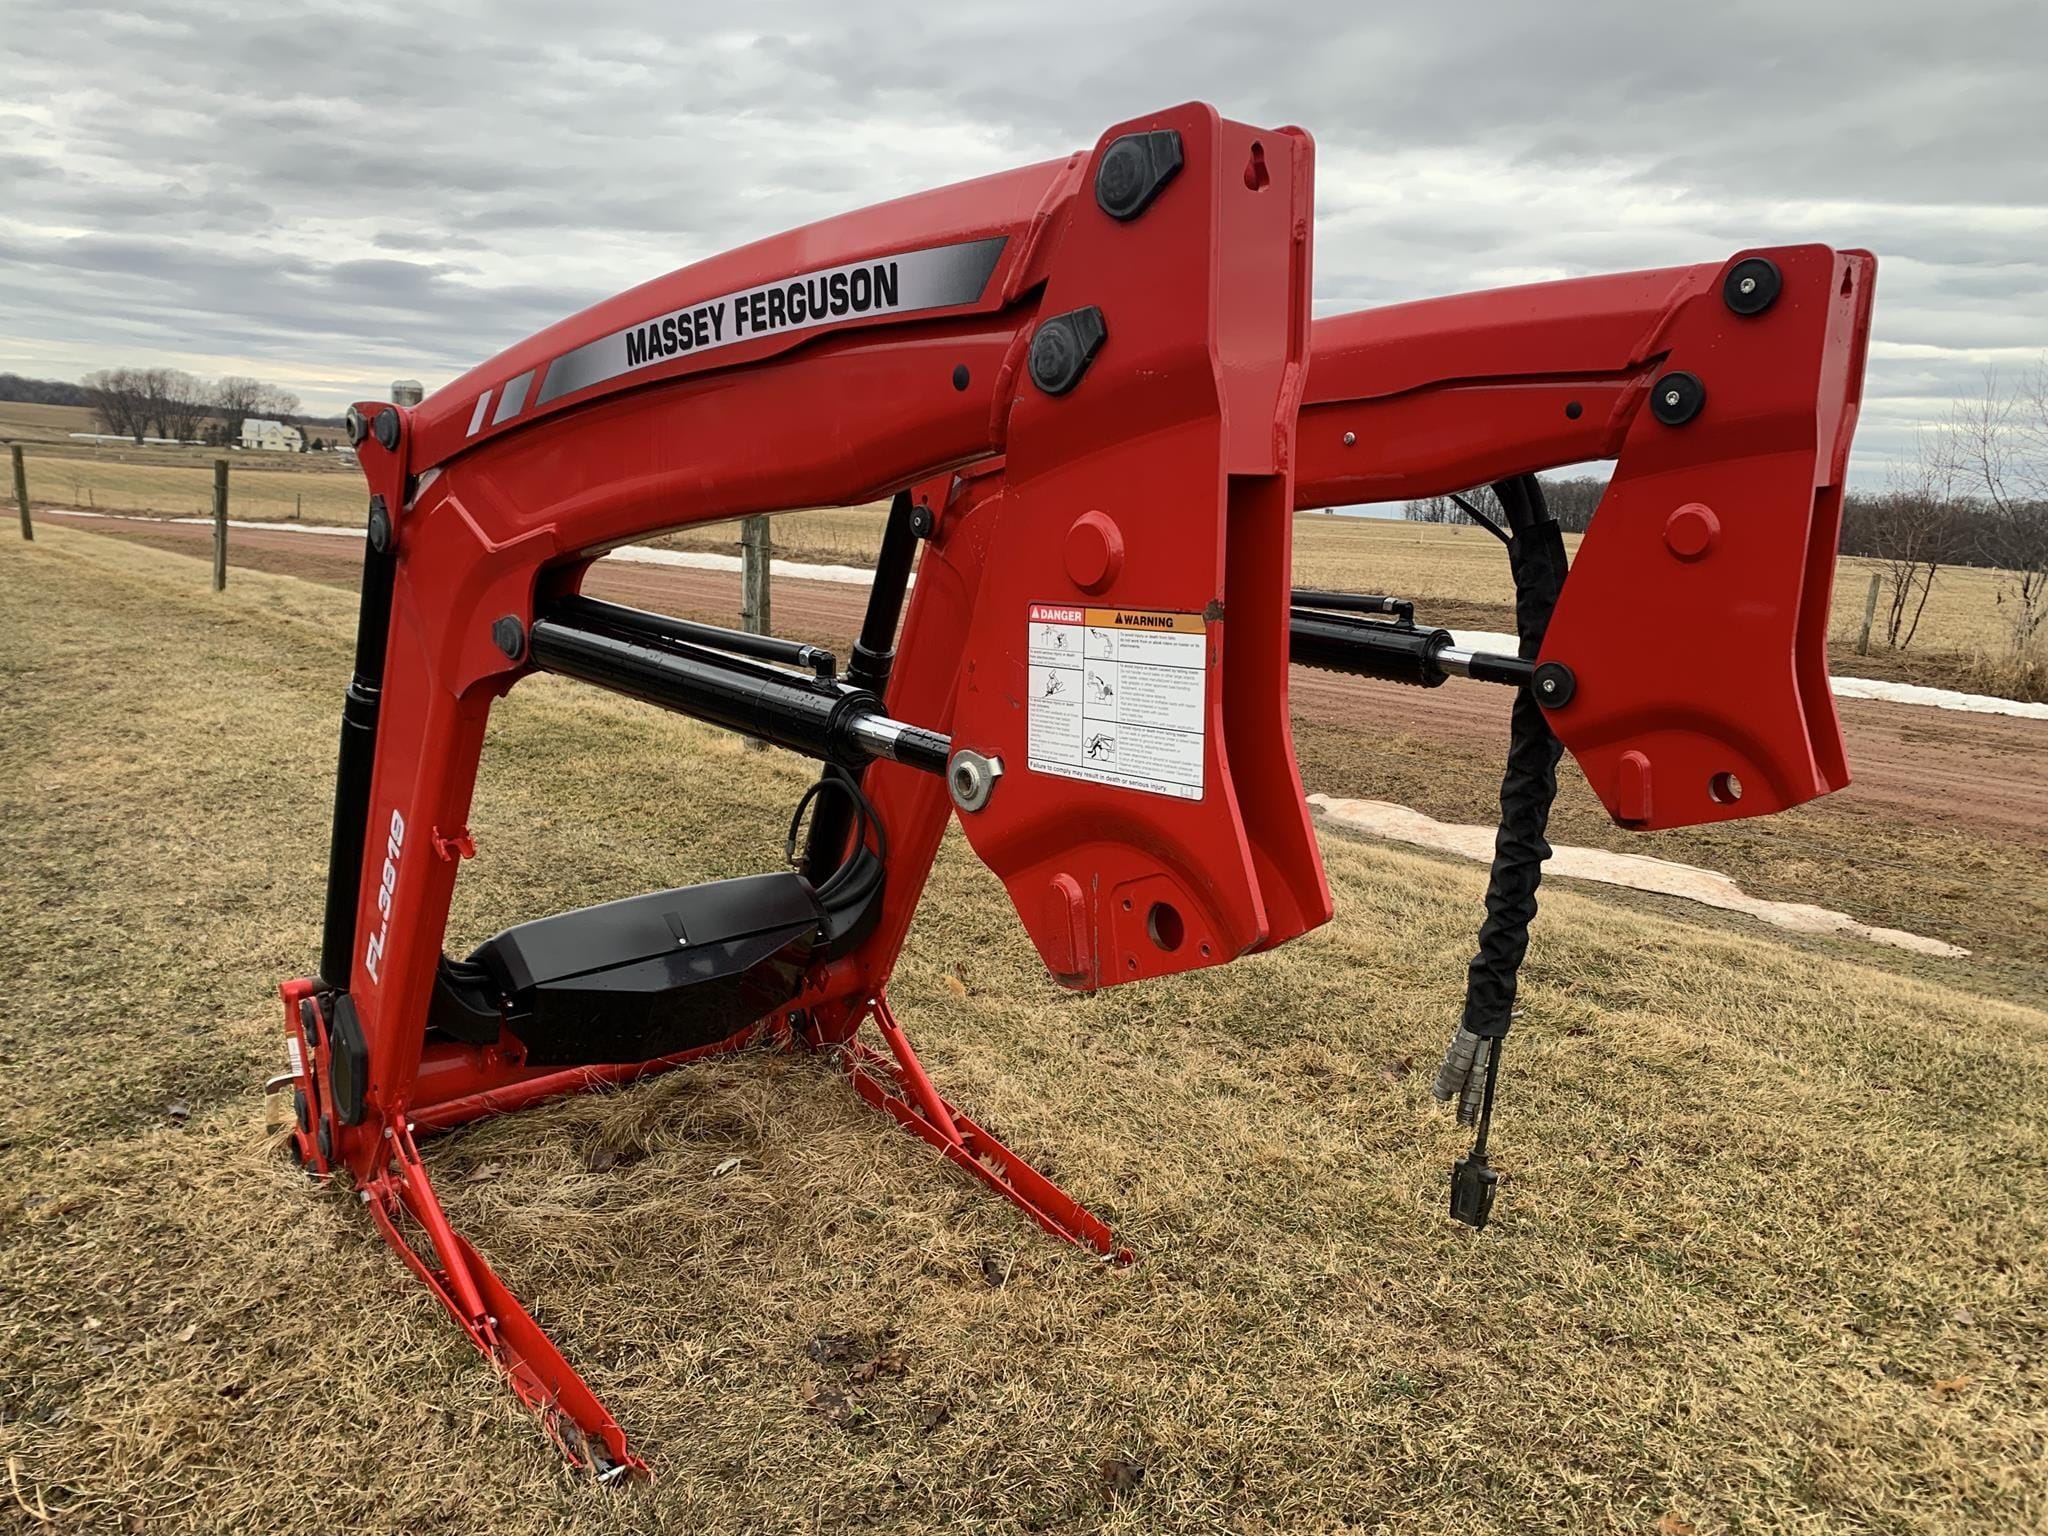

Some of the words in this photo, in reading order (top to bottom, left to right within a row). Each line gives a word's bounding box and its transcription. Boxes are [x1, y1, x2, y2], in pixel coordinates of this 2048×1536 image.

[626, 302, 725, 366] MASSEY
[734, 262, 898, 336] FERGUSON
[1040, 609, 1082, 622] DANGER
[1124, 614, 1174, 628] WARNING
[1030, 761, 1047, 769] Failure
[1053, 766, 1071, 776] comply
[1084, 770, 1099, 779] result
[1106, 775, 1121, 783] death
[1129, 779, 1149, 788] serious
